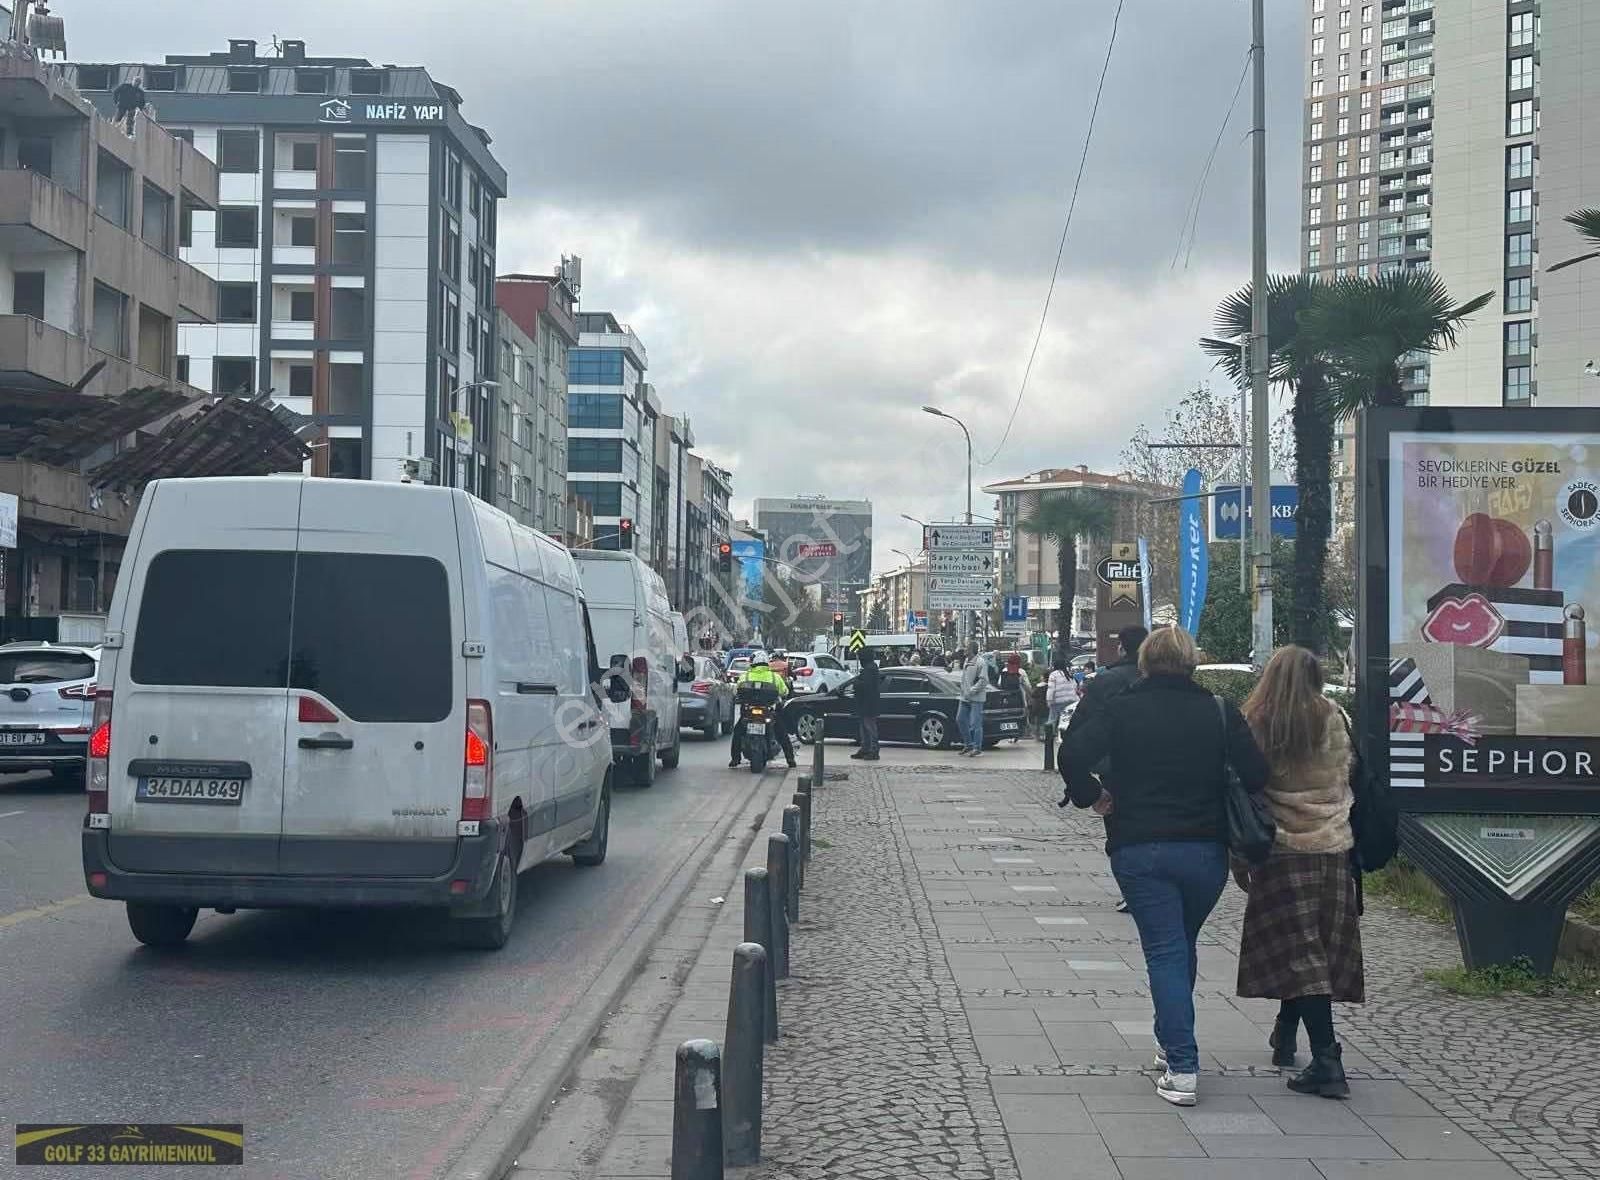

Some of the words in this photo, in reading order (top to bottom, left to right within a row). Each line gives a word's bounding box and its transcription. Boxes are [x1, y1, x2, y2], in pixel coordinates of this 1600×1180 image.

[366, 103, 406, 119] NAFİZ
[413, 106, 443, 119] YAPI
[1418, 460, 1508, 473] SEVDİKLERİNE
[1512, 458, 1560, 473] GÜZEL
[1418, 476, 1437, 488] BİR
[1442, 476, 1489, 488] HEDİYE
[931, 554, 959, 563] Saray
[1009, 599, 1022, 616] H
[148, 779, 167, 796] 34
[169, 780, 204, 797] DAA
[208, 781, 239, 798] 849
